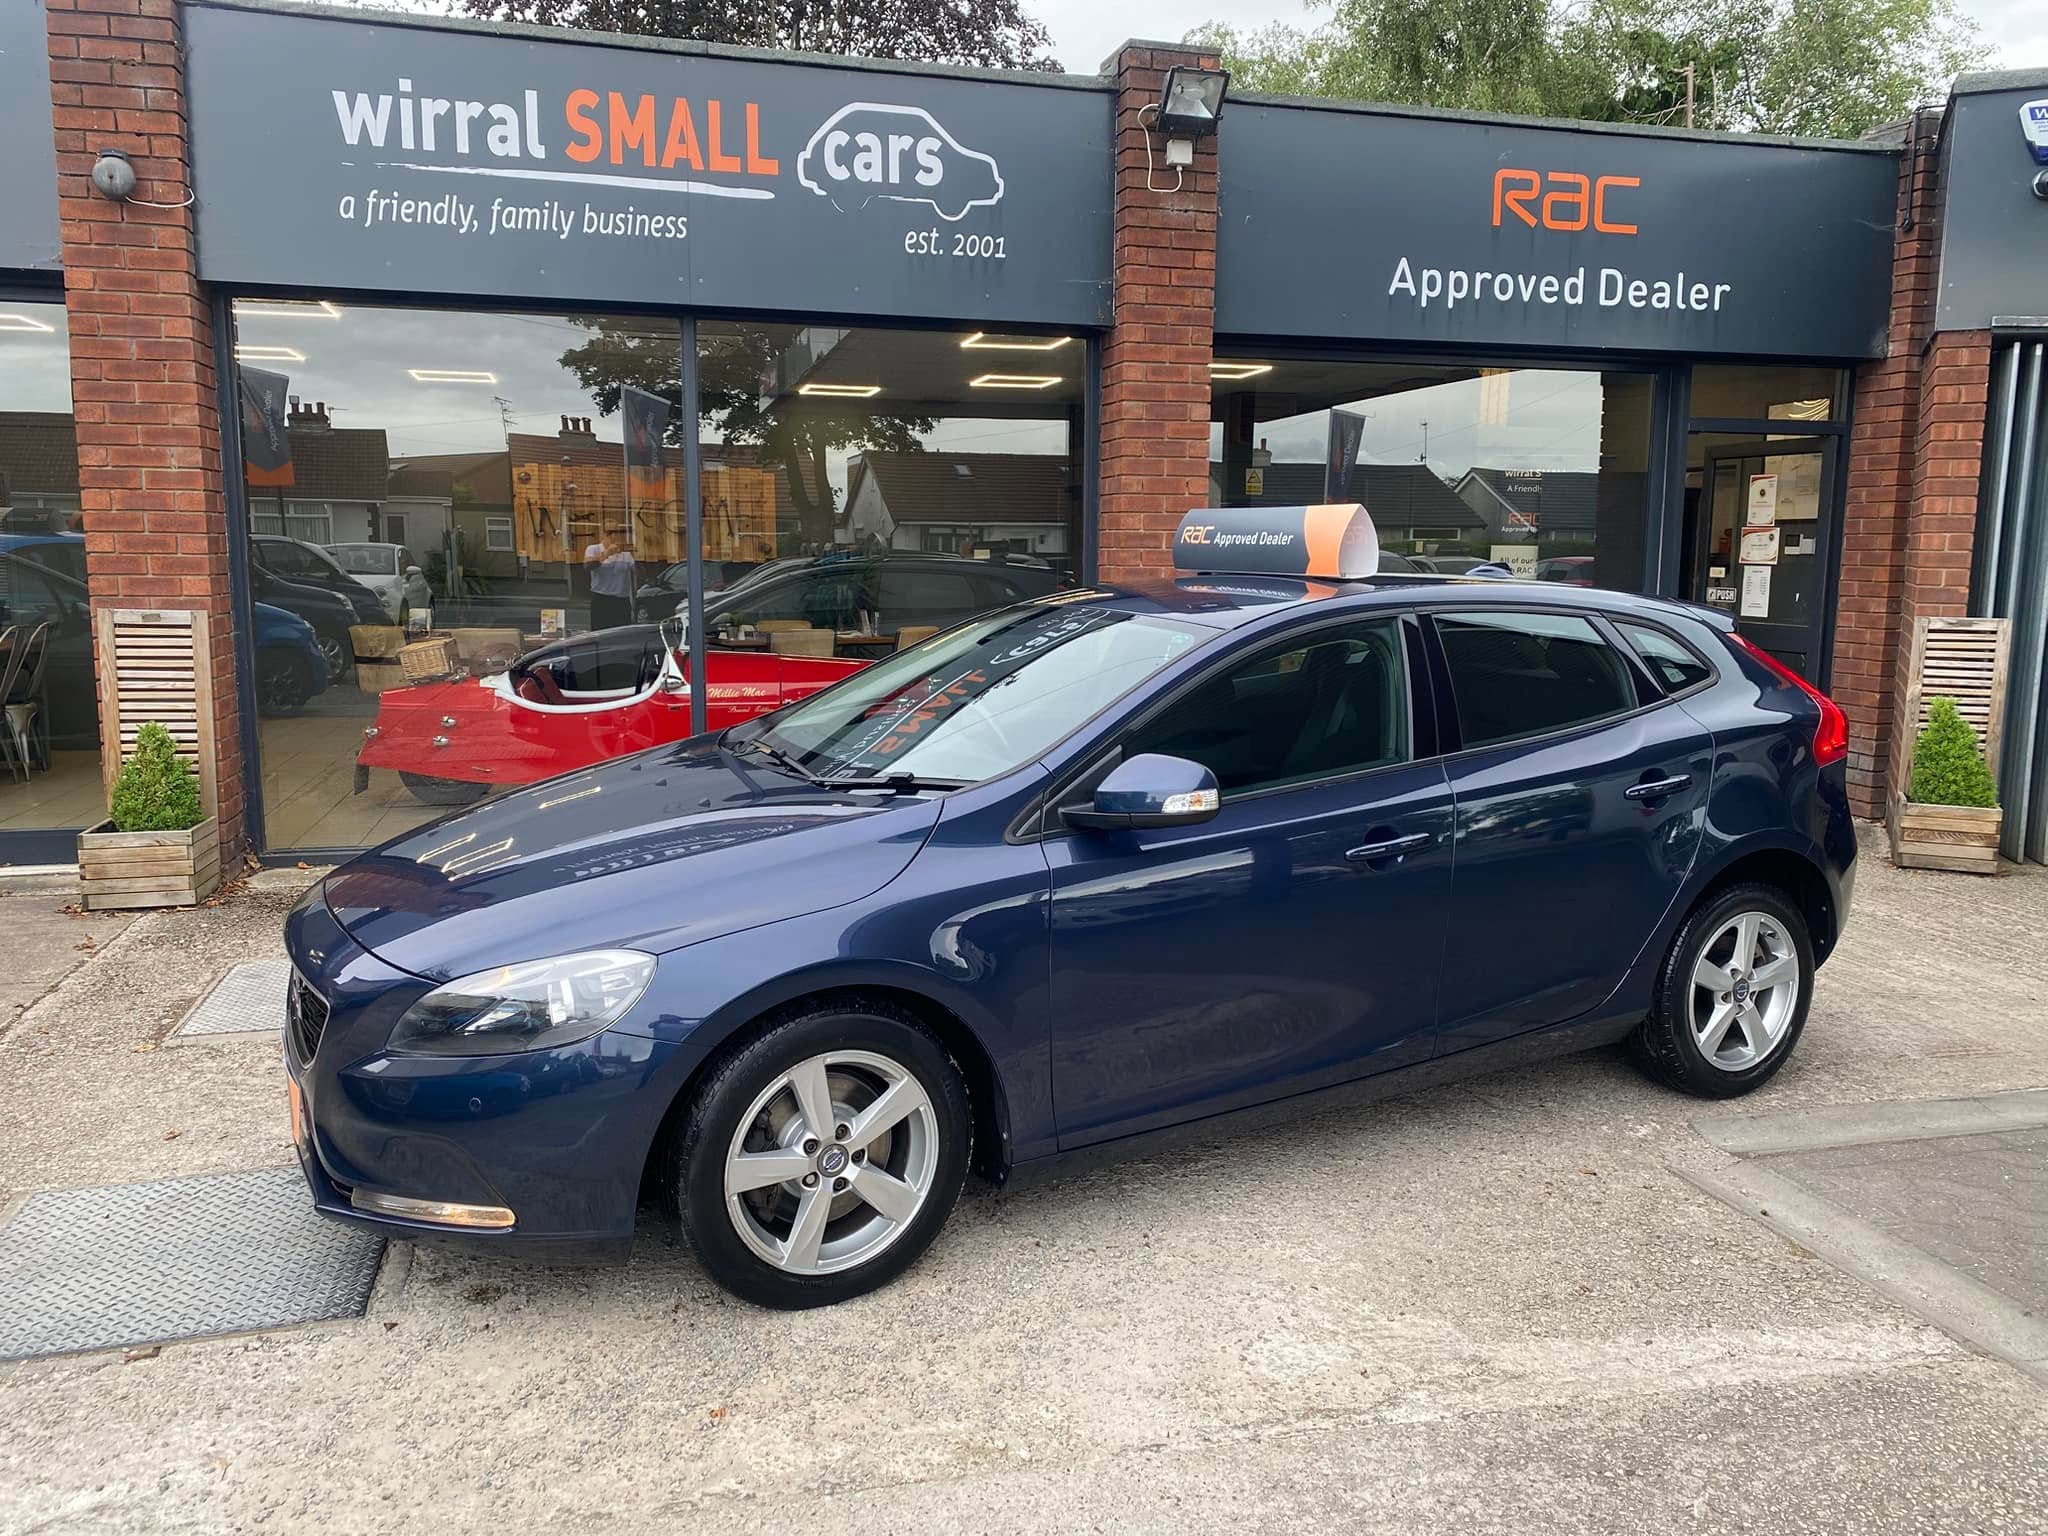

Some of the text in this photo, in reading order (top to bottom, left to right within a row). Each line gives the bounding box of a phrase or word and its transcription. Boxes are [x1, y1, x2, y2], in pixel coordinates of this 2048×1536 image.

[331, 78, 944, 186] wirral SMALL cars
[338, 189, 688, 240] a friendly, family business
[903, 230, 1007, 260] est. 2001
[1388, 256, 1732, 312] Approved Dealer
[1213, 531, 1258, 548] Approved
[1259, 531, 1294, 546] Dealer
[1716, 590, 1735, 600] PUSH
[708, 687, 740, 698] Millie
